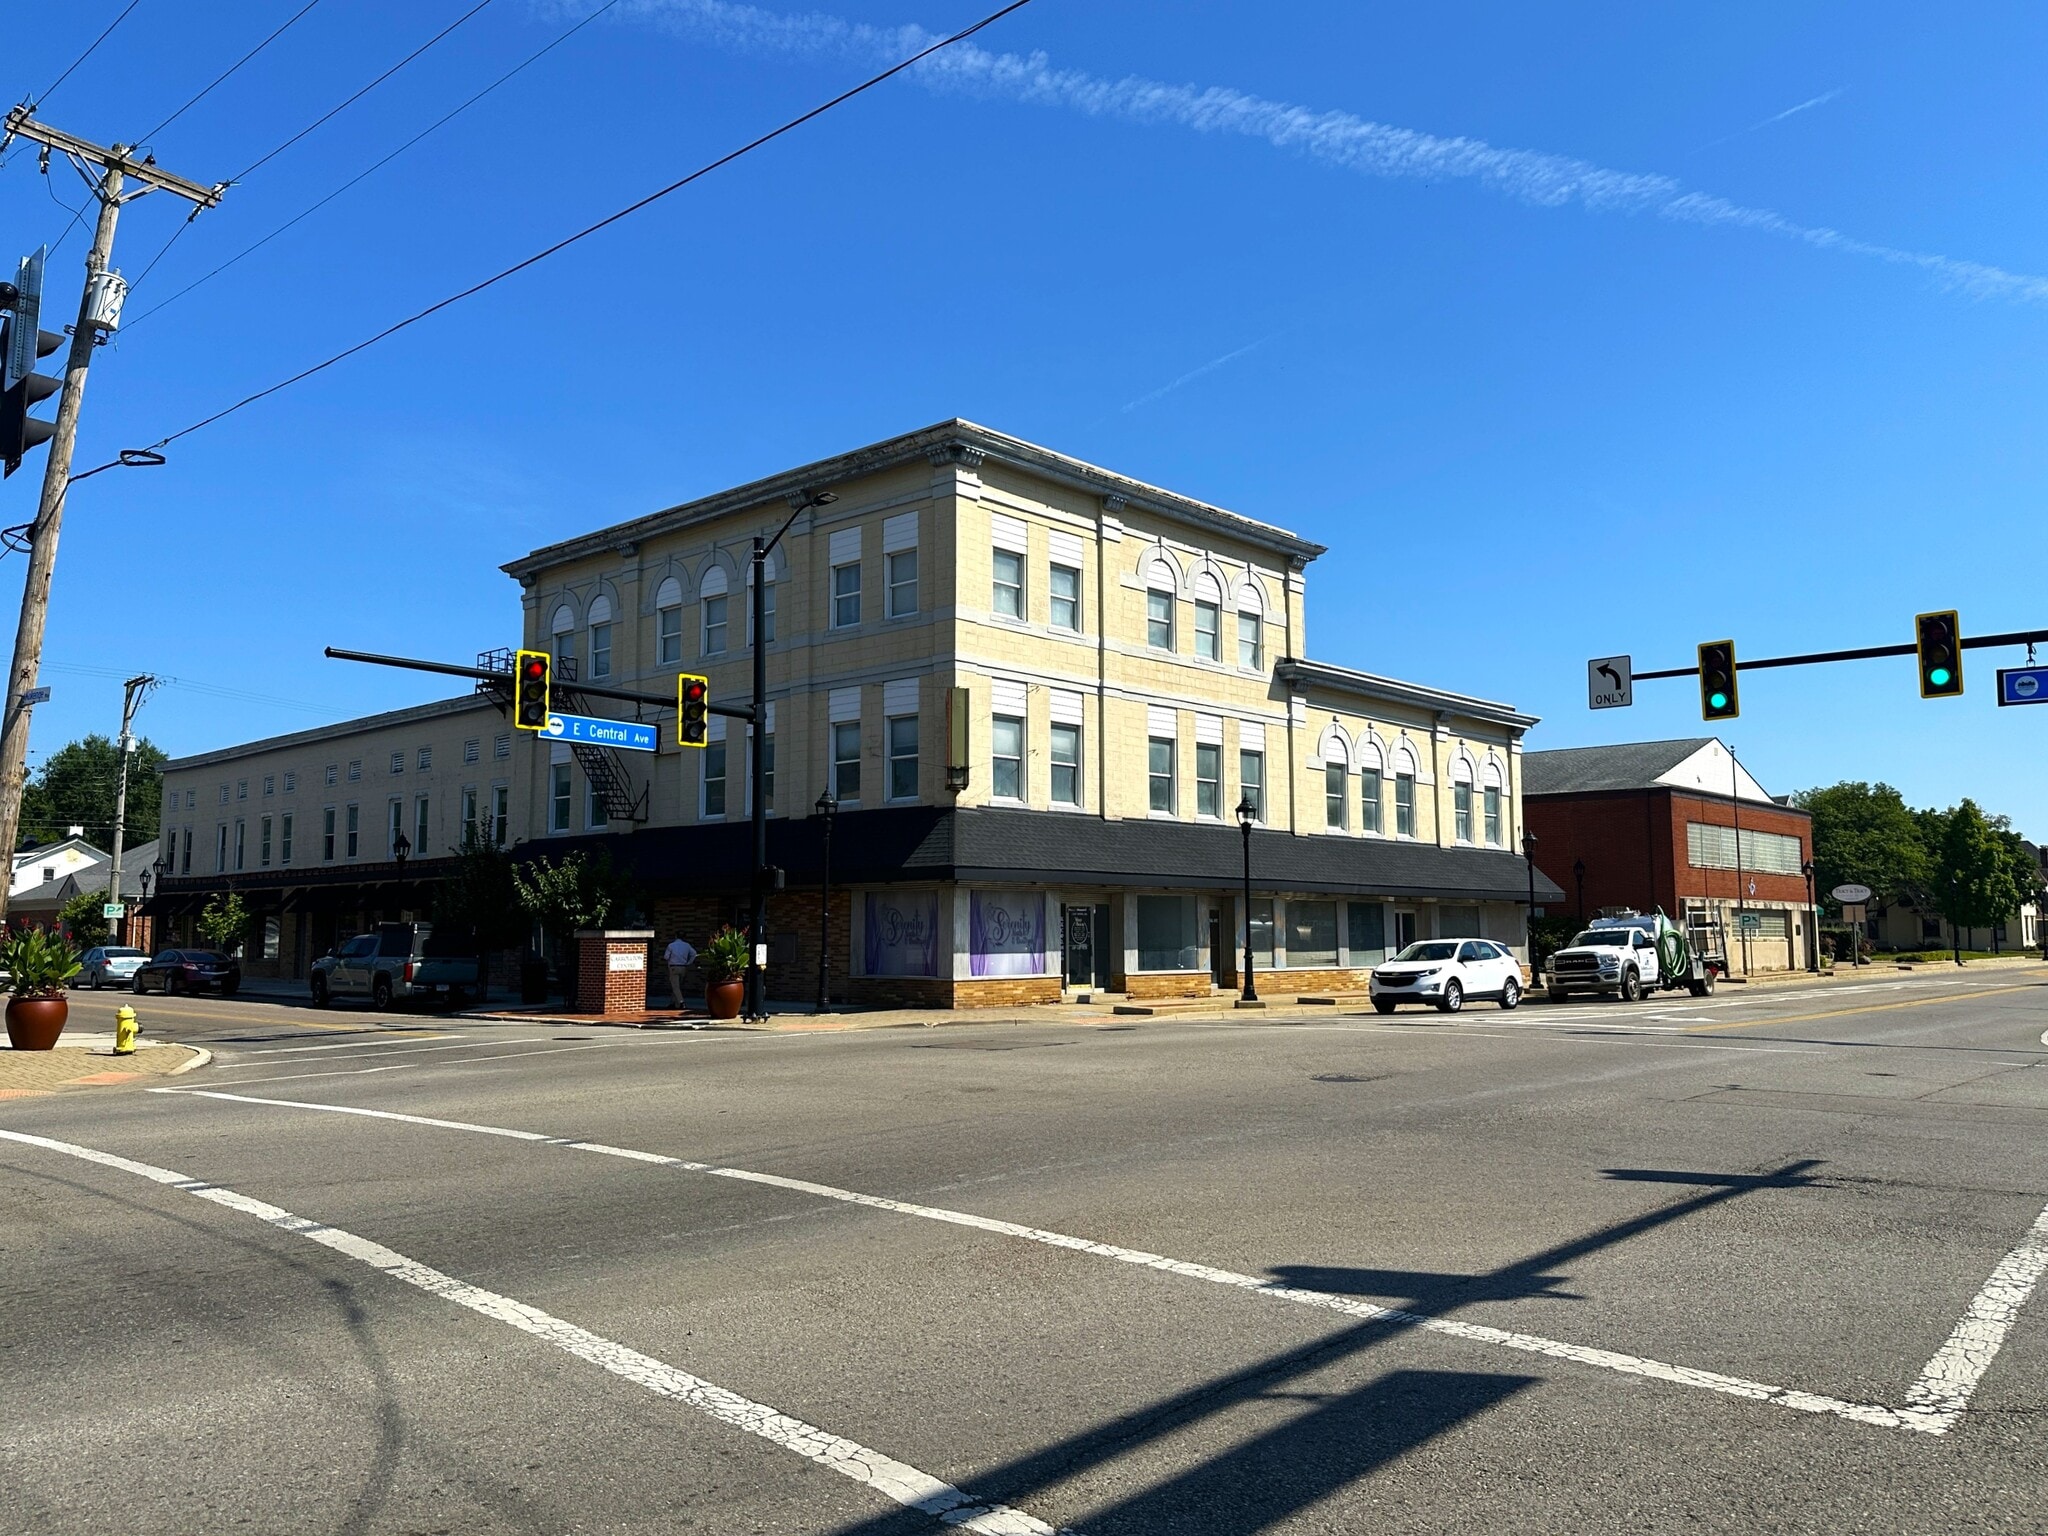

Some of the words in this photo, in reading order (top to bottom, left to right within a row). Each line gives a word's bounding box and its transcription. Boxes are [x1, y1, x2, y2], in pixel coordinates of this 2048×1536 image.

[1595, 692, 1626, 705] ONLY
[573, 722, 580, 736] E
[589, 724, 627, 741] Central
[634, 733, 649, 744] Ave
[106, 906, 116, 916] P
[993, 908, 1030, 941] Serenity
[1742, 915, 1751, 926] P
